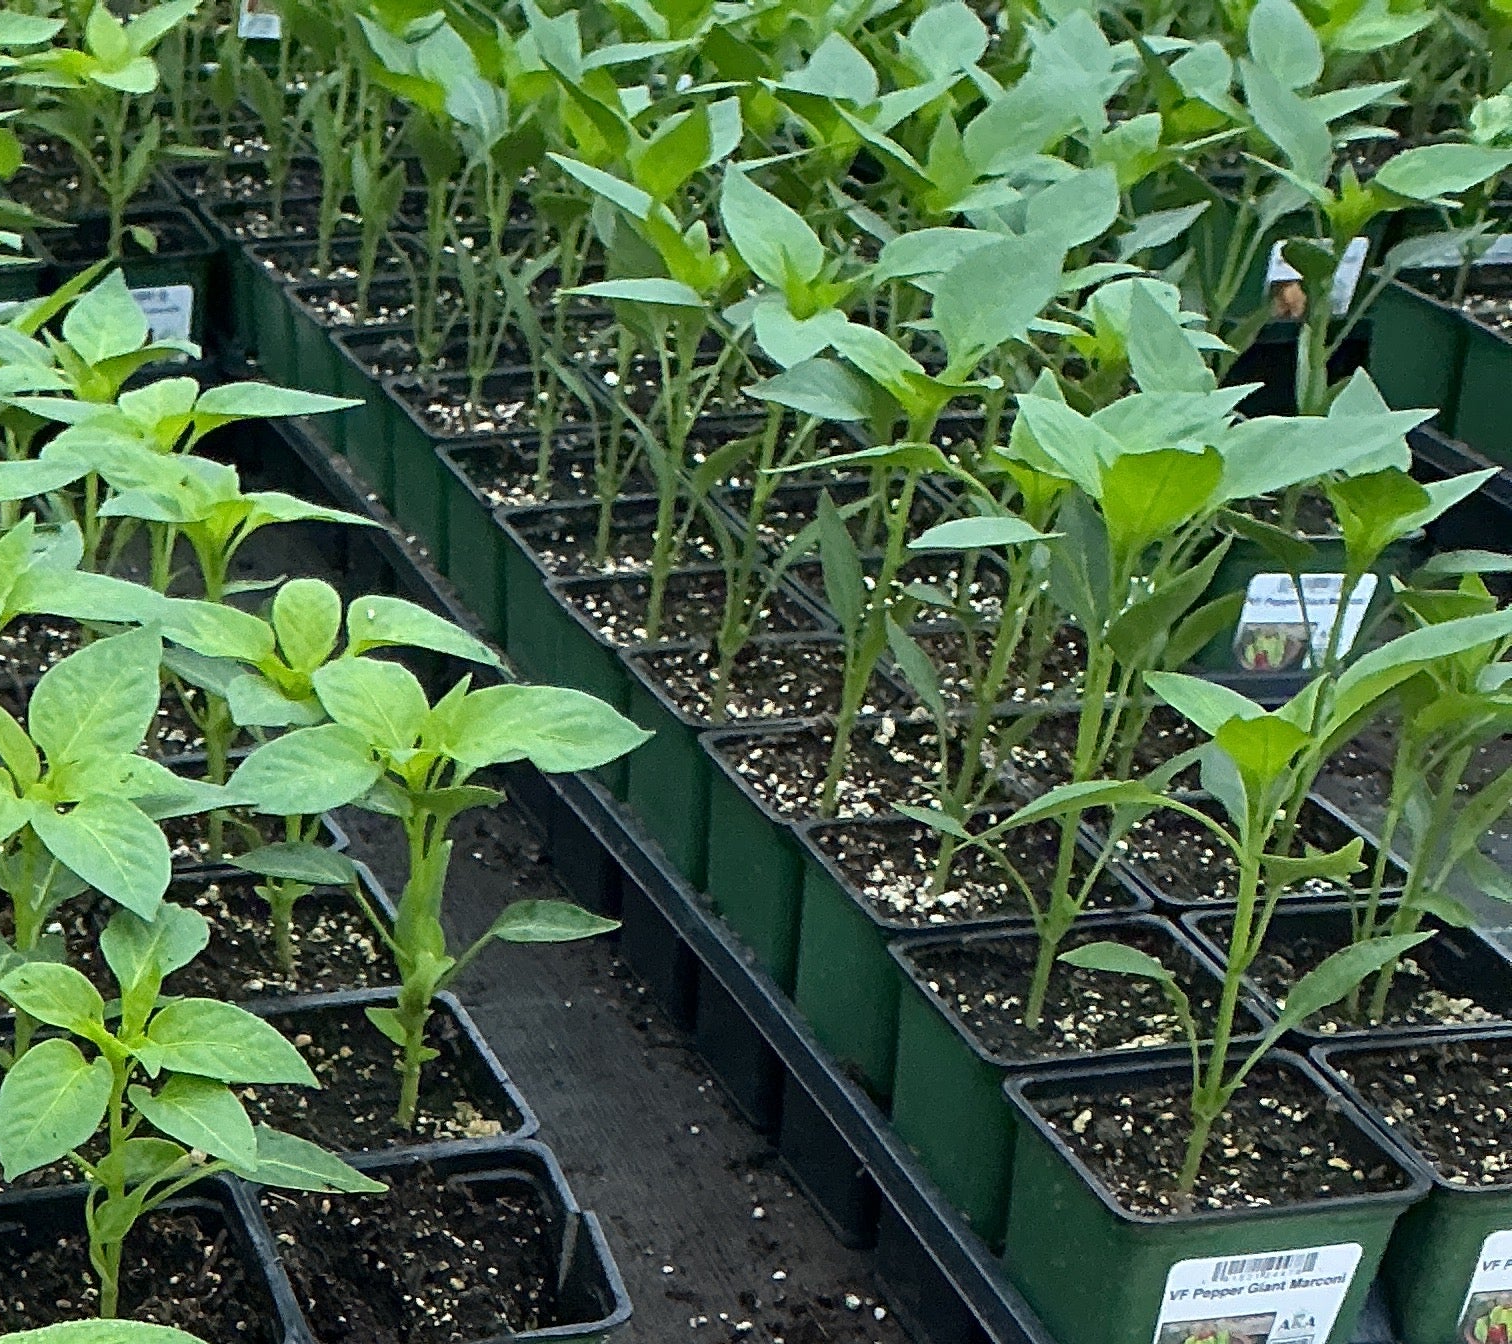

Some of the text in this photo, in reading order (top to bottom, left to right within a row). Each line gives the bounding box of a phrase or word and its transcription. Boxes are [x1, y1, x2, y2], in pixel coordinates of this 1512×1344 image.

[1483, 1260, 1501, 1271] VF
[1169, 1289, 1189, 1300] VF
[1192, 1287, 1244, 1300] Pepper
[1248, 1281, 1286, 1293] Giant
[1289, 1272, 1347, 1289] Marconi
